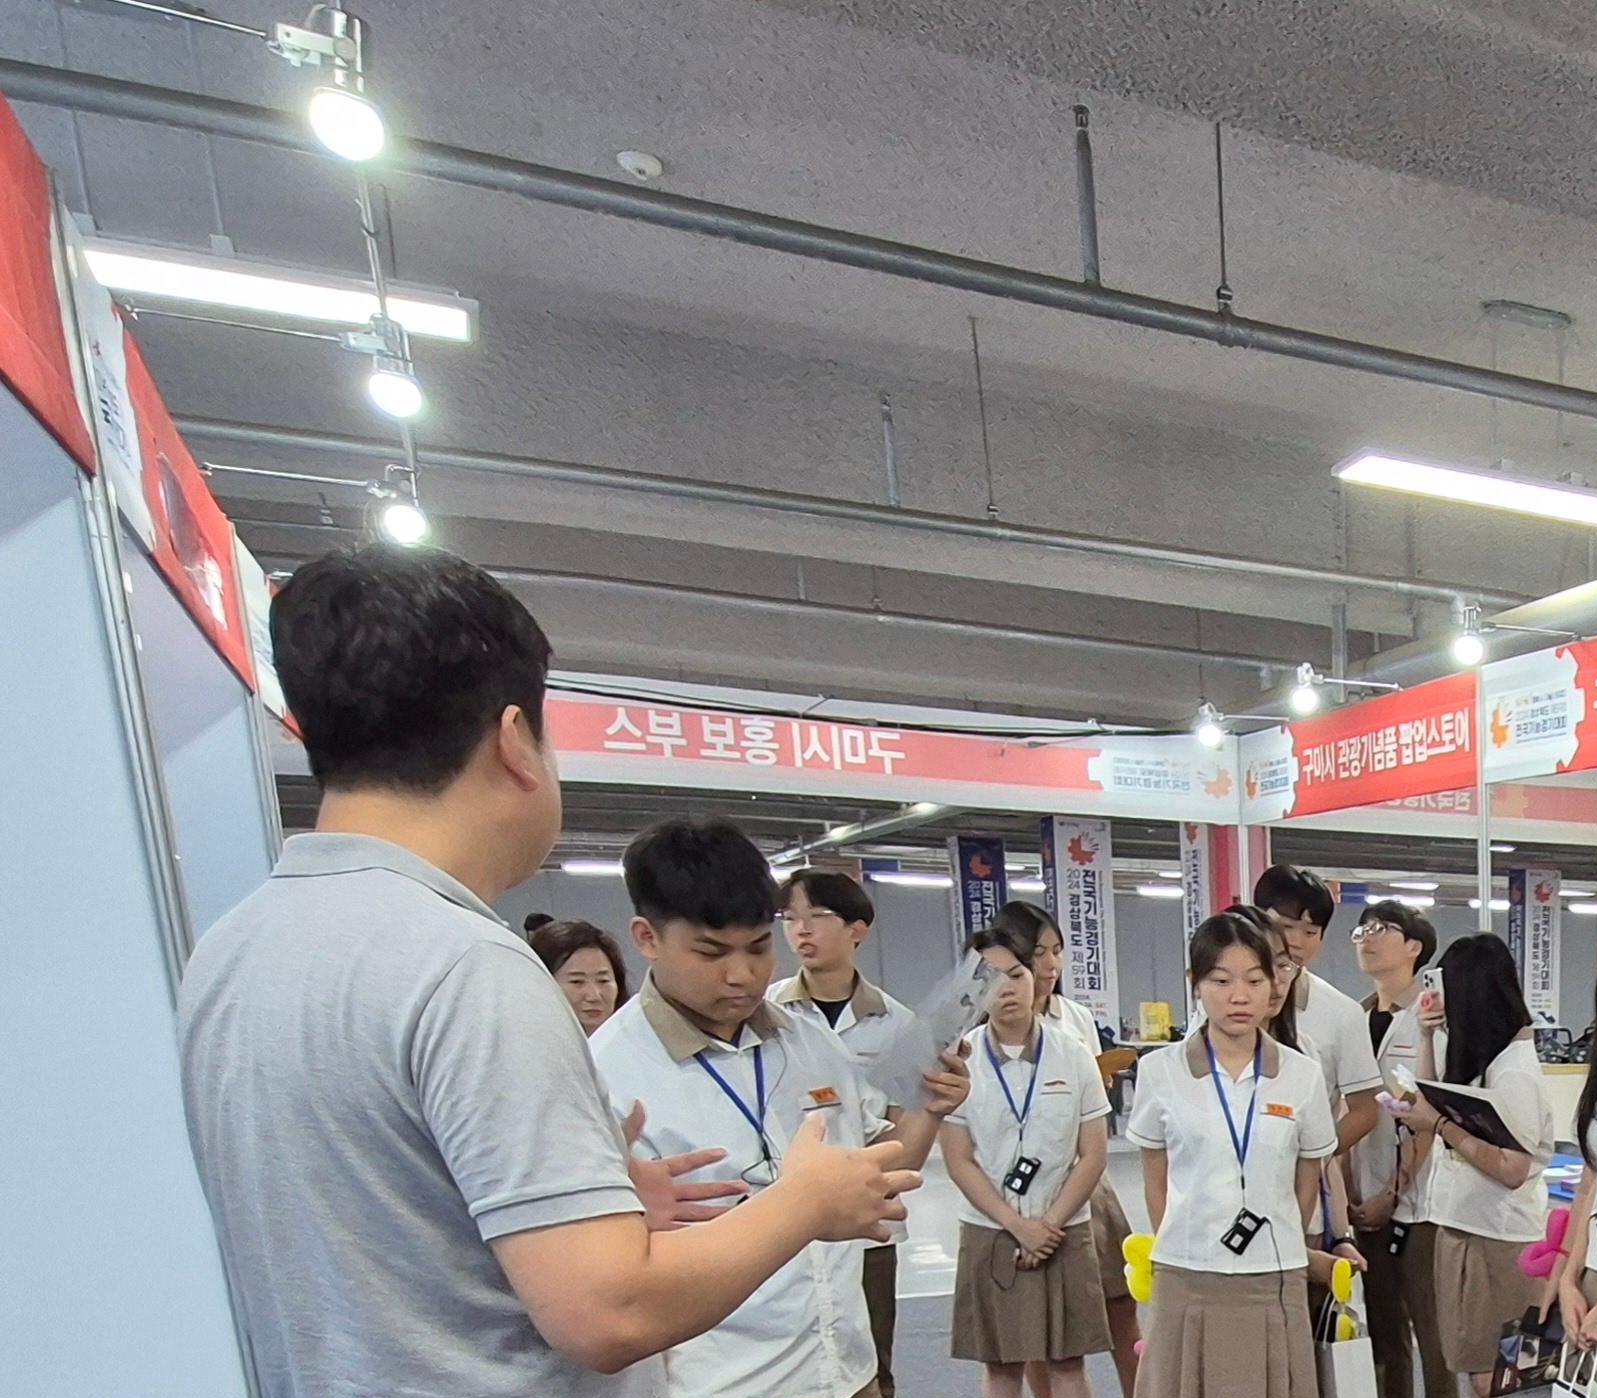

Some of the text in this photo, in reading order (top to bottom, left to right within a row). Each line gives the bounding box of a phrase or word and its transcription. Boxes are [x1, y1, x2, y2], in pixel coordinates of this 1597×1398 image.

[1303, 745, 1335, 786] 구미시
[1338, 727, 1397, 778] 관광기념품
[1399, 707, 1470, 765] 팝업스토어
[1069, 893, 1083, 947] 경상북도
[1082, 869, 1101, 991] 전국기능경기대회
[1072, 951, 1085, 990] 제59회
